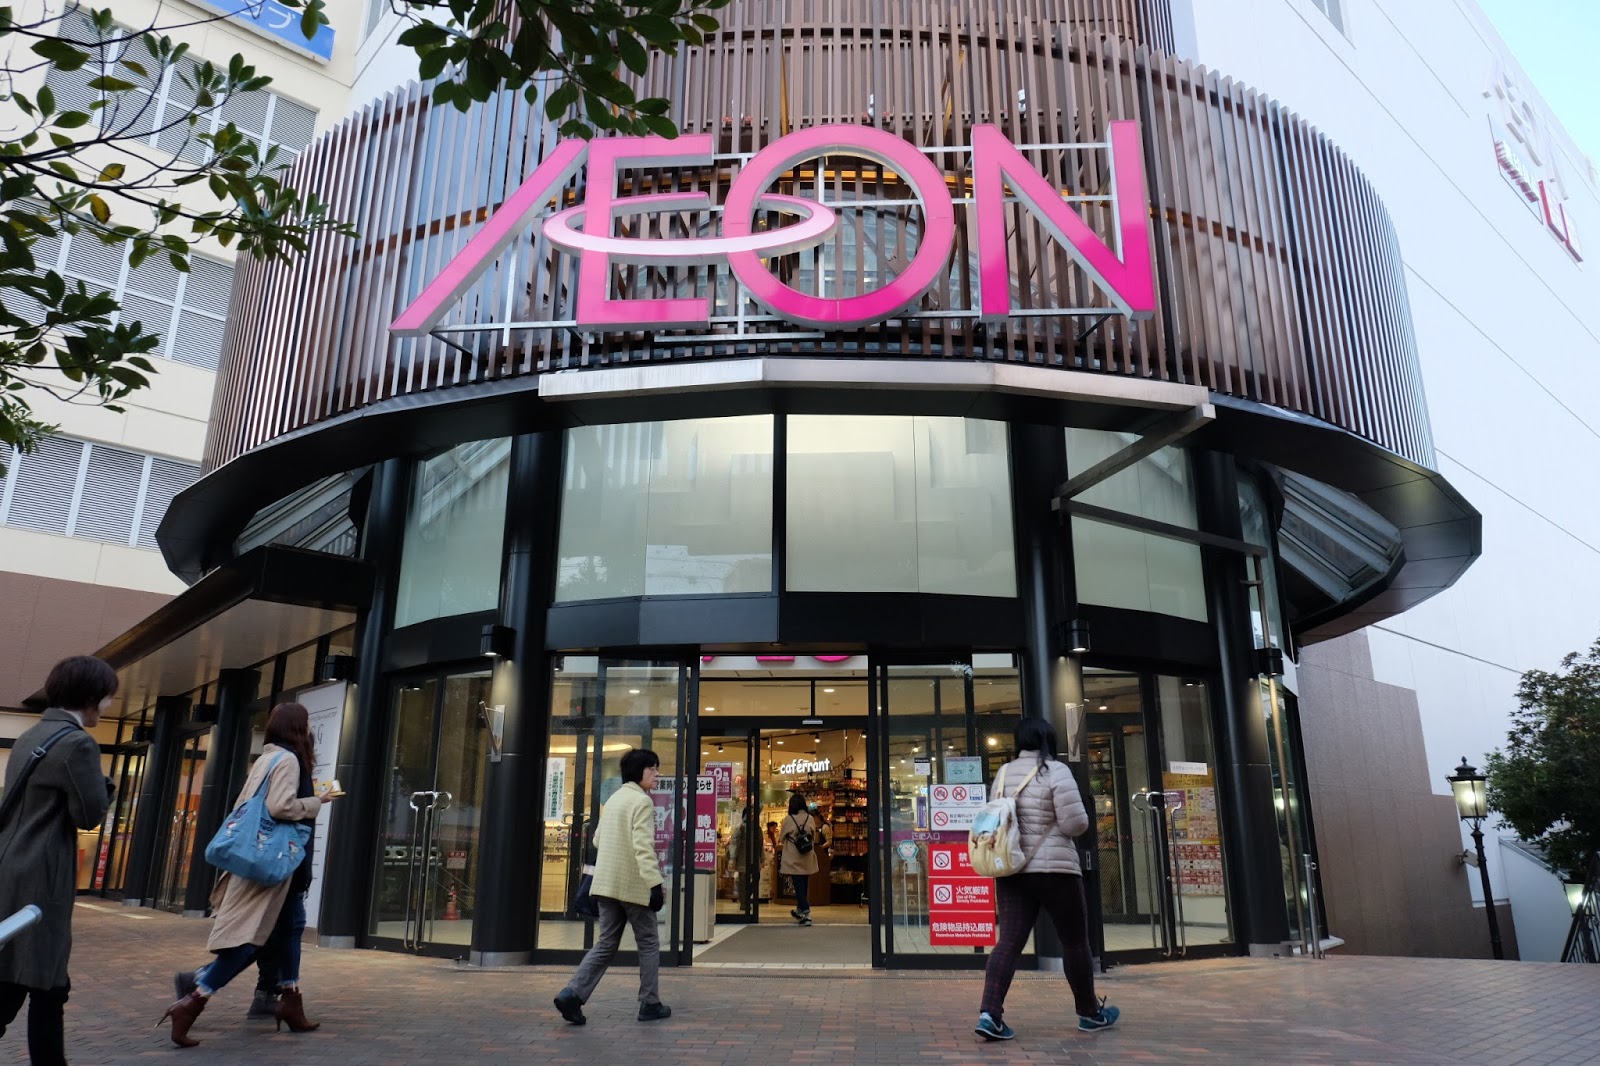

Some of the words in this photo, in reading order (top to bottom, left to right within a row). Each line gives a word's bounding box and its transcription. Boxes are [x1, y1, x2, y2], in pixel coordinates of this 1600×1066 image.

[956, 886, 989, 895] 火気厳禁
[932, 922, 993, 932] 危険物品持込厳禁
